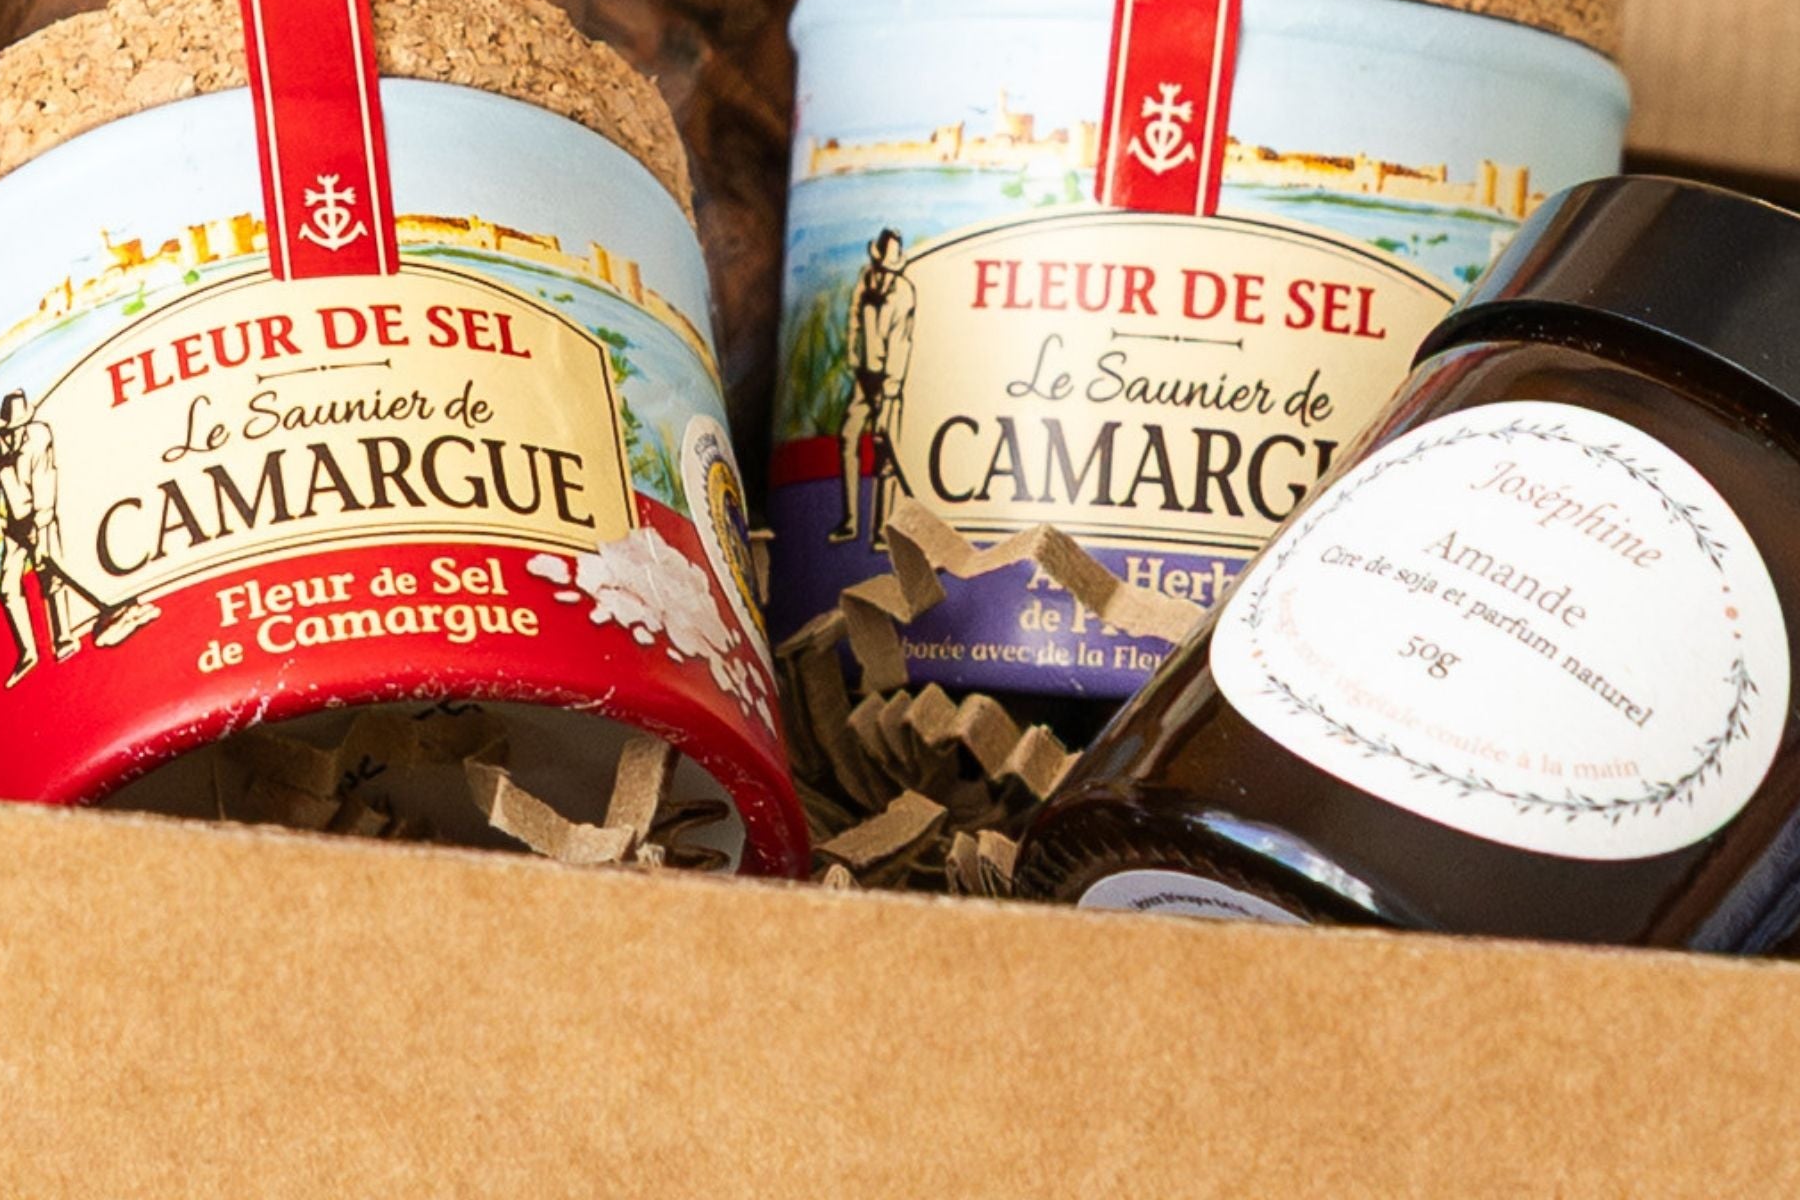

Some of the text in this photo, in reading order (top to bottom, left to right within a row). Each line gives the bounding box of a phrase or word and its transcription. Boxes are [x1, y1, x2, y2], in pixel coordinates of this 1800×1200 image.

[971, 260, 1387, 340] FLEUR DE SEL
[104, 303, 532, 409] FLEUR DE SEL
[1006, 334, 1334, 427] Le Saunier de
[162, 378, 495, 465] Le Saunier de
[95, 433, 596, 578] CAMARGUE
[928, 413, 1339, 524] CAMARG
[1470, 460, 1663, 569] Joséphine
[217, 556, 508, 630] Fleur de Sel
[1019, 600, 1061, 632] de
[1126, 557, 1234, 601] Herb
[1423, 530, 1587, 629] Amande
[196, 603, 541, 674] de Camargue
[903, 638, 1167, 671] borée avec de la Fle
[1365, 555, 1393, 577] de
[1394, 565, 1439, 594] soja
[1442, 587, 1467, 606] et
[1463, 599, 1560, 660] parfum
[1561, 655, 1655, 729] naturel
[1397, 634, 1462, 681] 50g
[1540, 752, 1564, 777] la
[1573, 757, 1641, 782] main
